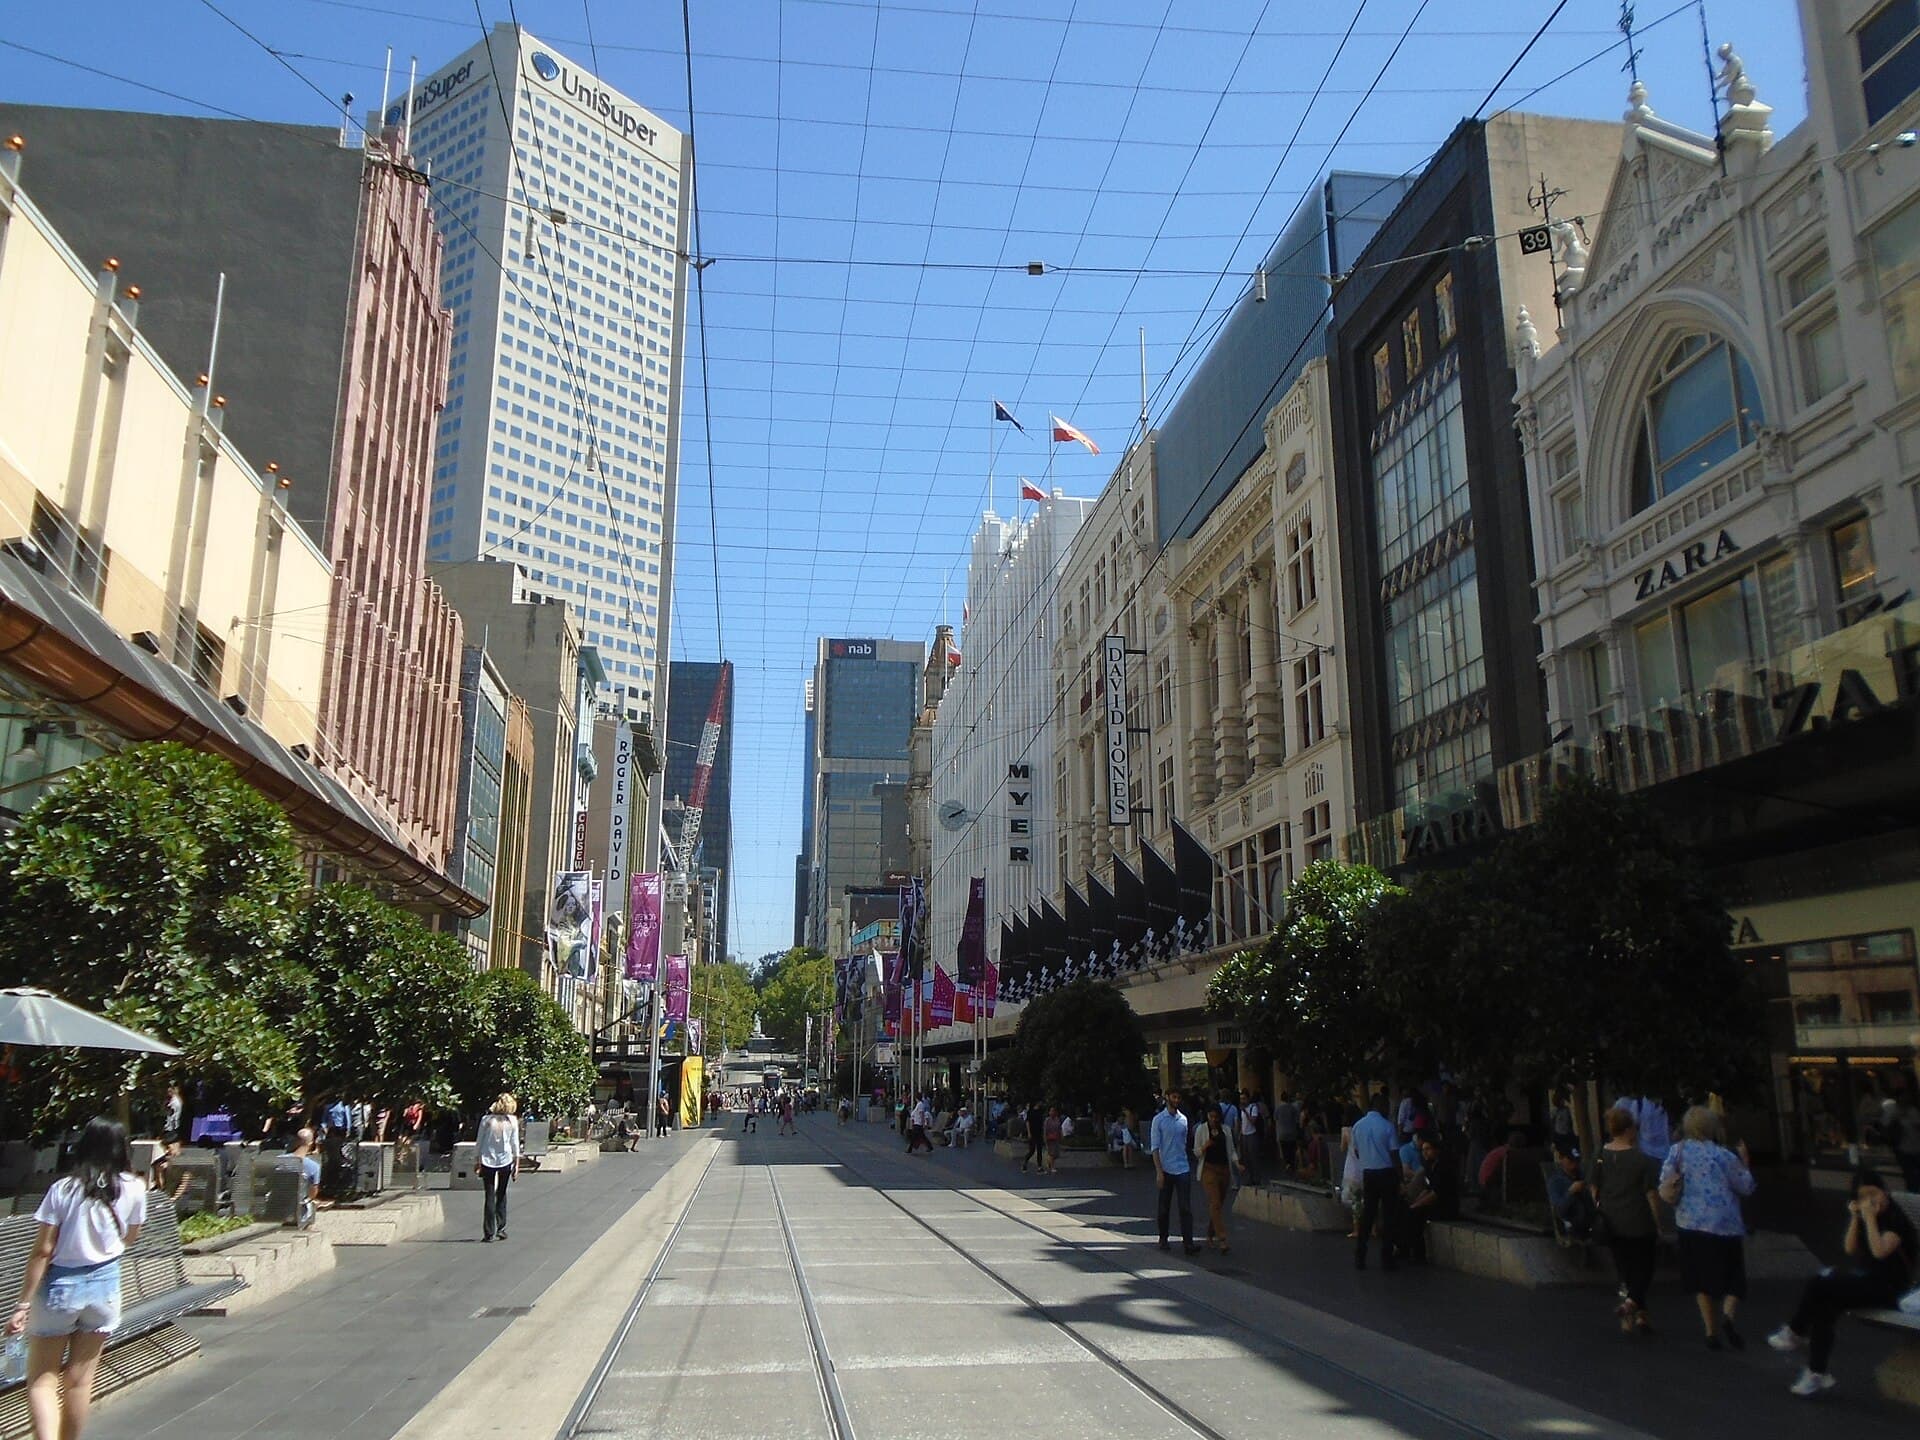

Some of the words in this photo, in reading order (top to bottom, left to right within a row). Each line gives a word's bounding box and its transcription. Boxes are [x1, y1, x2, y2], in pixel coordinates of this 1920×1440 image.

[562, 67, 658, 146] UniSuper
[1523, 230, 1549, 250] 39
[1633, 529, 1741, 601] ZARA
[848, 643, 872, 655] nab
[1108, 647, 1125, 725] DAVID
[616, 740, 629, 805] ROGER
[1111, 731, 1126, 815] JONES
[611, 815, 623, 881] DAVID
[1008, 764, 1030, 862] MYER
